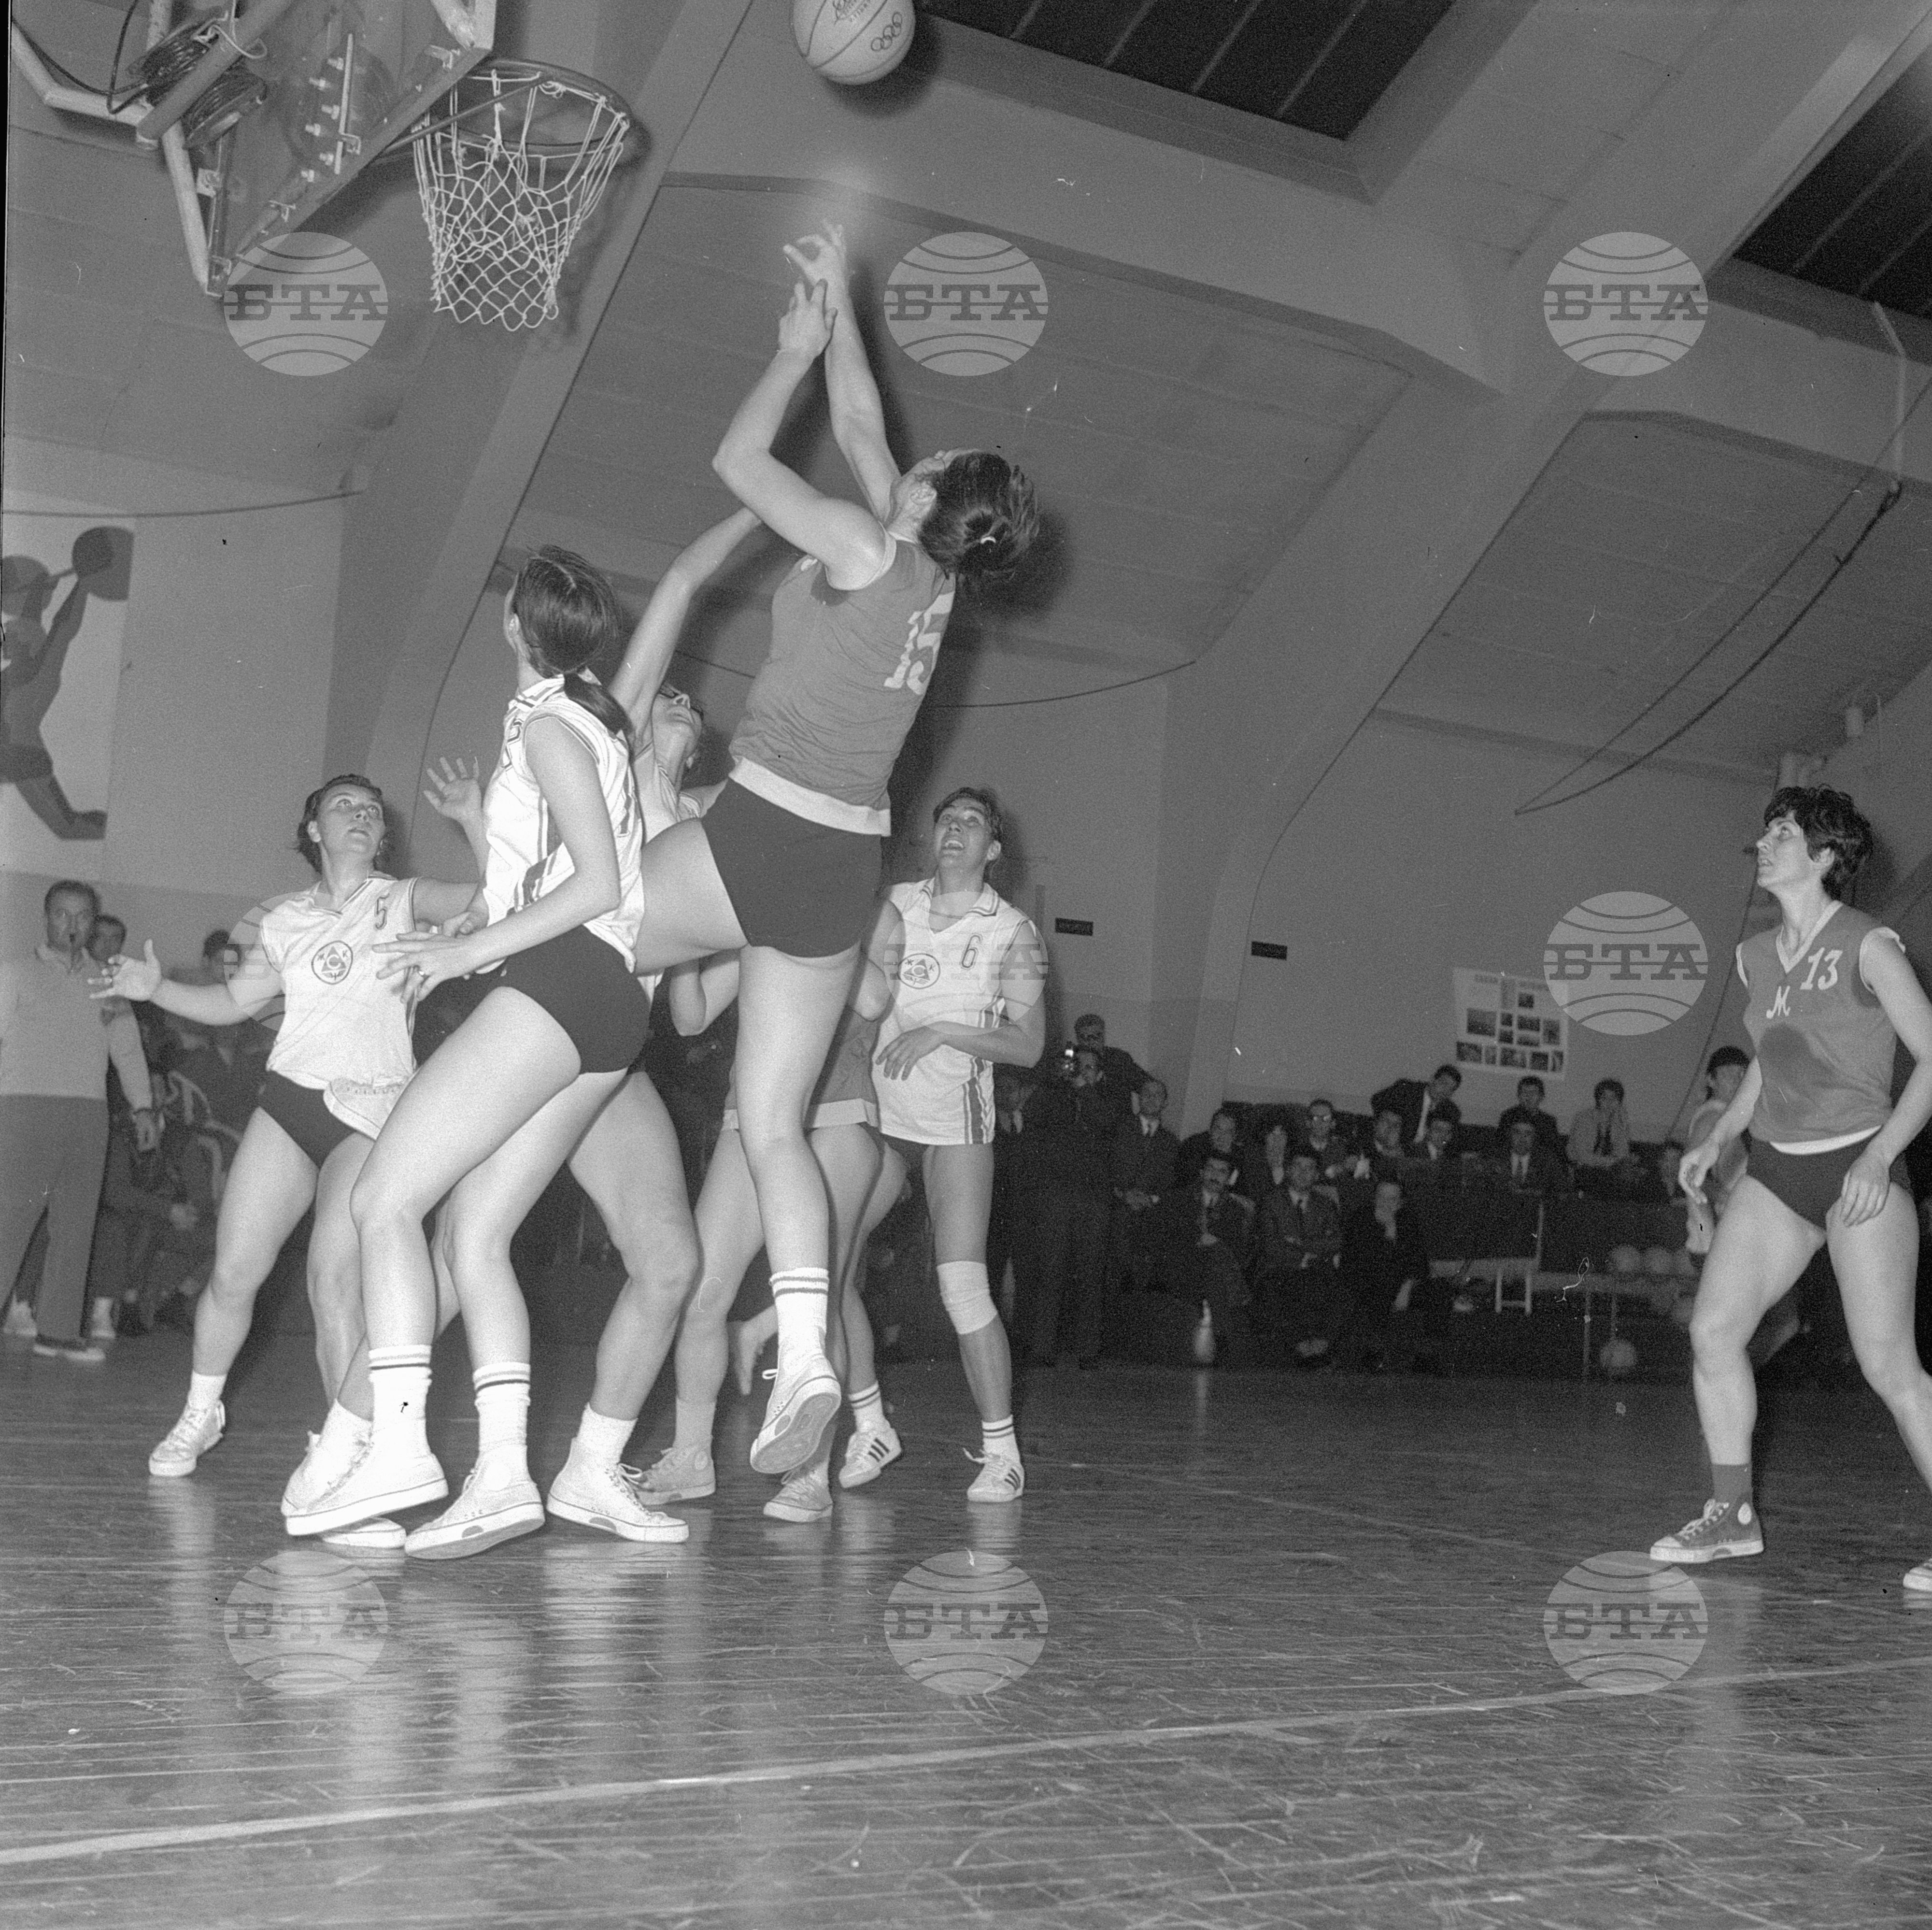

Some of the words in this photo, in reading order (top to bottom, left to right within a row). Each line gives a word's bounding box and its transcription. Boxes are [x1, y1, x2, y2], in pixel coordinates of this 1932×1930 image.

[375, 893, 390, 930] 5
[960, 933, 983, 970] 6
[1800, 947, 1843, 990] 13
